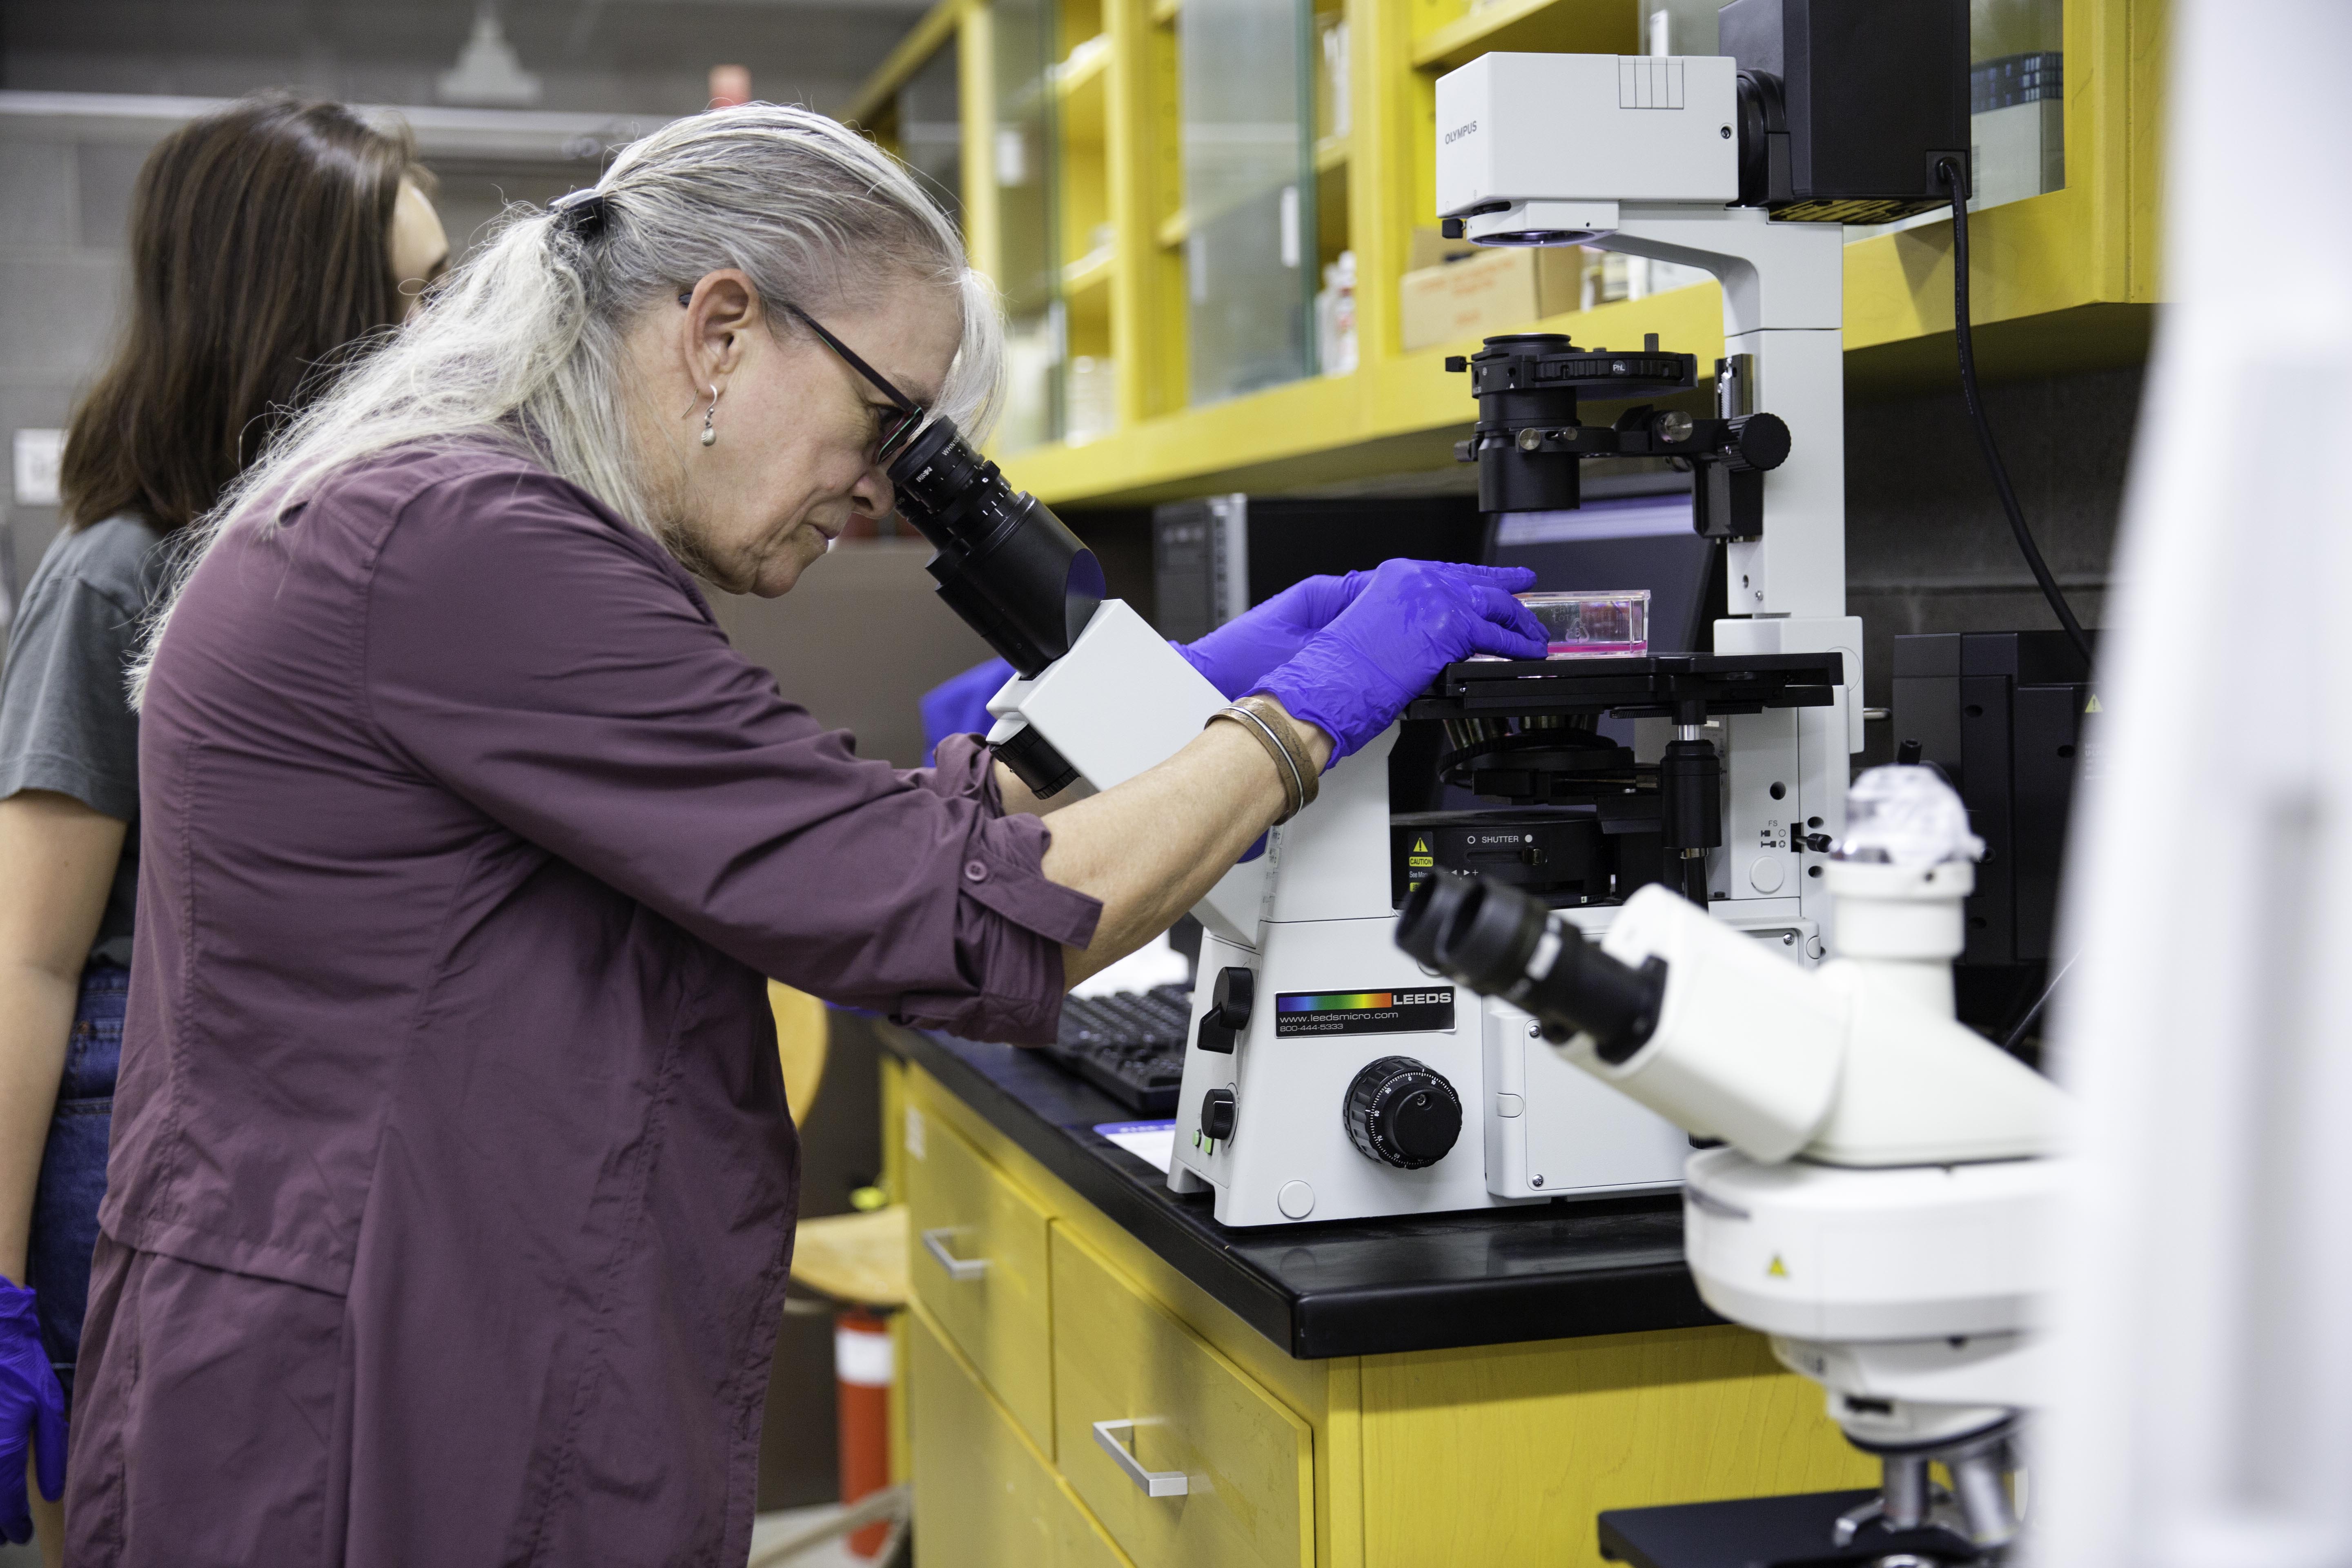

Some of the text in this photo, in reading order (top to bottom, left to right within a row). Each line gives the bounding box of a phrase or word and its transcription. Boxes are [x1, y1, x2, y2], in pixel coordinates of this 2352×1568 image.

[1445, 120, 1477, 144] OLYMPUS
[1393, 993, 1451, 1005] LEEDS
[1279, 1012, 1399, 1023] www.leedsmicro.com
[1279, 1024, 1343, 1032] 800-444-5333
